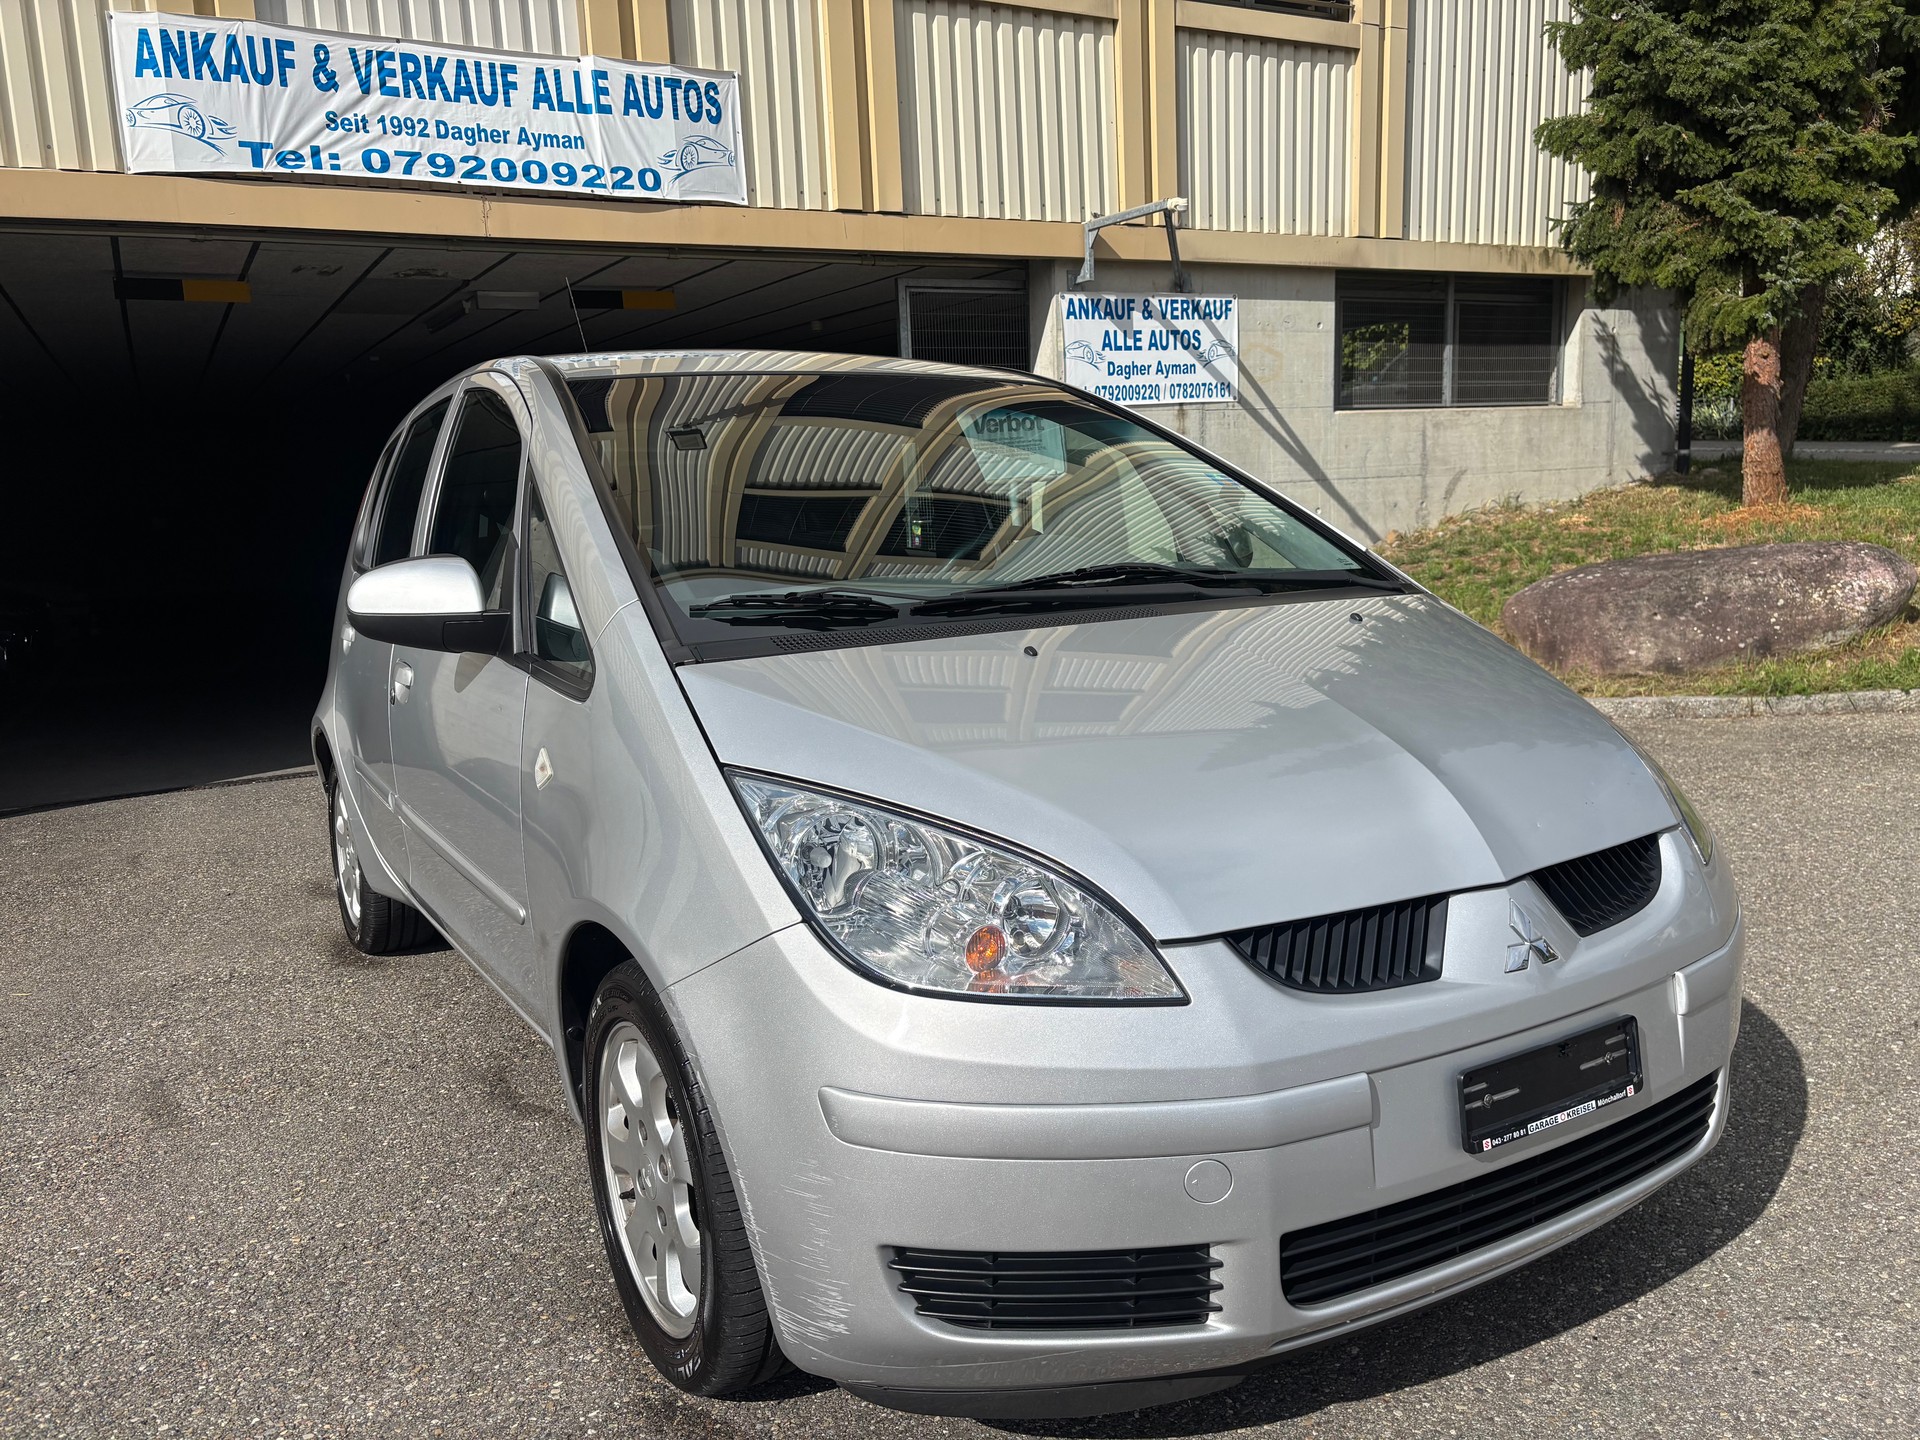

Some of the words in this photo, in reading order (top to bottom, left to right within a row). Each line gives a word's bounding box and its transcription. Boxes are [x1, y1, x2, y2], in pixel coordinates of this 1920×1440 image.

[135, 28, 296, 88] ANKAUF
[312, 43, 340, 93] &
[348, 47, 519, 107] VERKAUF
[532, 67, 613, 115] ALLE
[623, 74, 722, 125] AUTOS
[324, 110, 369, 134] Seit
[377, 115, 430, 138] 1992
[436, 119, 510, 146] Dagher
[517, 126, 585, 150] Ayman
[238, 141, 341, 171] Tel:
[361, 148, 662, 192] 0792009220
[1066, 298, 1135, 320] ANKAUF
[1142, 298, 1153, 320] &
[1158, 298, 1233, 320] VERKAUF
[1101, 329, 1142, 351] ALLE
[1149, 329, 1202, 351] AUTOS
[1107, 361, 1152, 379] Dagher
[1156, 360, 1196, 379] Ayman
[1164, 383, 1167, 400] /
[1169, 382, 1231, 400] 0782076161
[971, 413, 1045, 434] Verbot
[1529, 1116, 1559, 1133] GARAGE
[1566, 1102, 1595, 1119] KREISEL
[1597, 1089, 1626, 1106] Mönchaltorf
